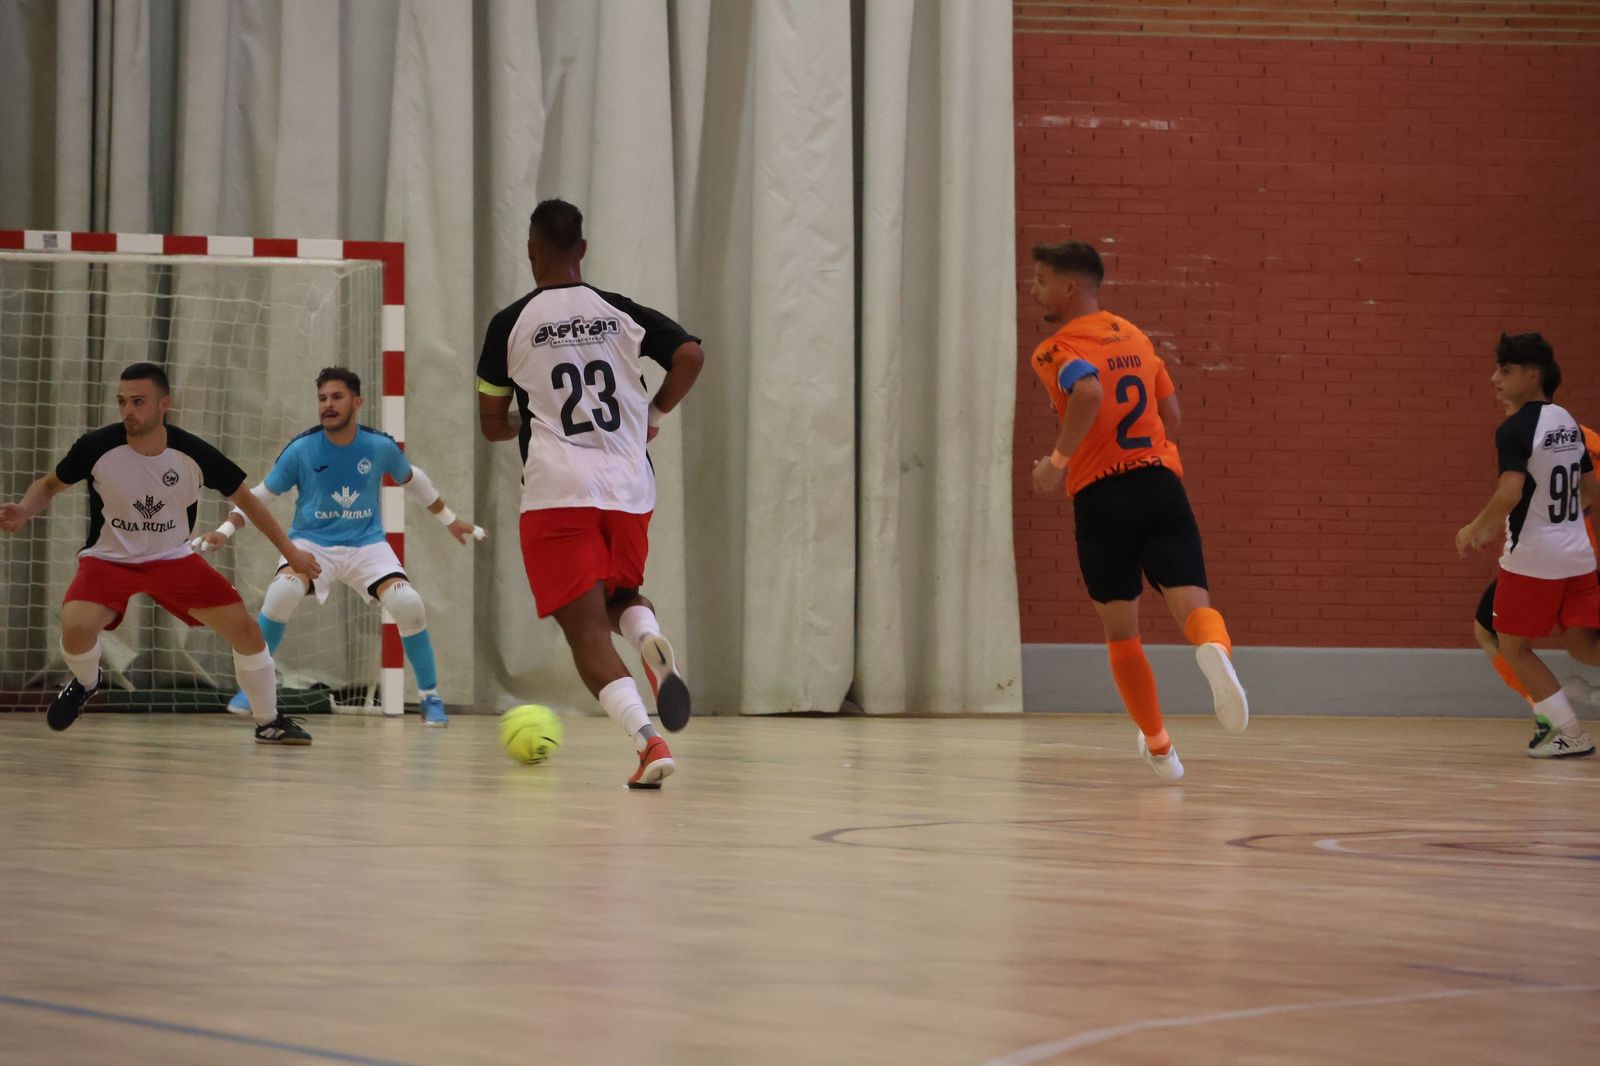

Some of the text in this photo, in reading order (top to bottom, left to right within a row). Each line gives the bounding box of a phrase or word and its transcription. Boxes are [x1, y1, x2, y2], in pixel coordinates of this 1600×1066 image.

[1107, 355, 1142, 371] DAVID
[551, 360, 621, 437] 23
[1115, 375, 1153, 450] 2
[1547, 463, 1580, 524] 98
[111, 518, 176, 533] CAJA RURAL
[314, 508, 373, 520] CAJA RURAL
